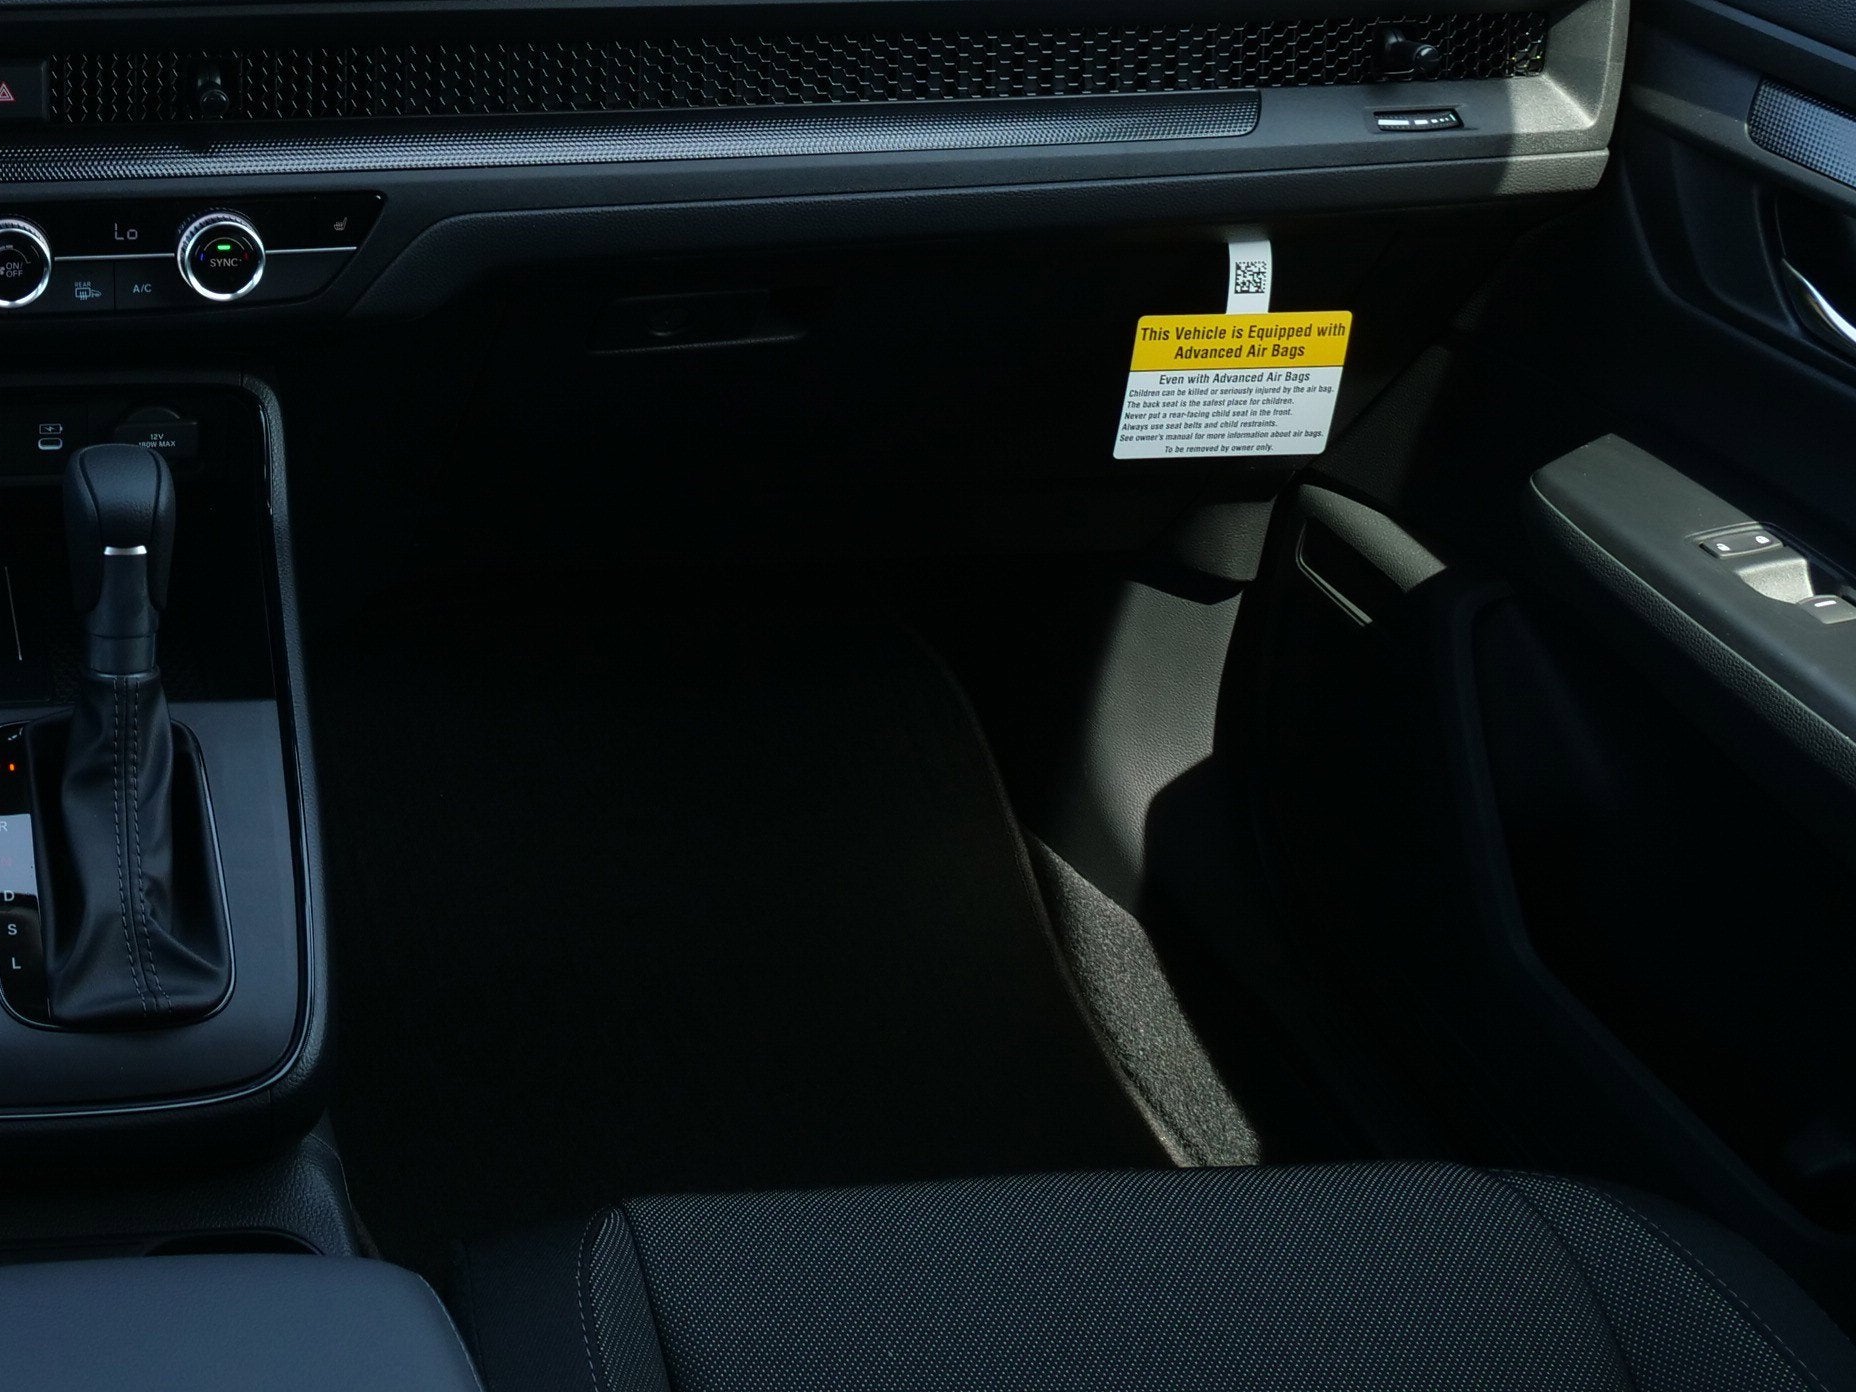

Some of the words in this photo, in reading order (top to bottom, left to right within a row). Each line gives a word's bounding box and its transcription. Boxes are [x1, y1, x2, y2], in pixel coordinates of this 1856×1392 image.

[114, 223, 138, 240] Lo
[210, 258, 238, 268] SYNC
[6, 270, 23, 278] OFF
[132, 283, 152, 293] A/C
[1141, 327, 1170, 341] This
[1175, 326, 1227, 340] Vehicle
[1231, 326, 1243, 339] is
[1248, 324, 1313, 341] Equipped
[1317, 323, 1346, 337] with
[1174, 345, 1243, 359] Advanced
[1246, 344, 1267, 358] Air
[1271, 344, 1305, 359] Bags
[1159, 374, 1184, 385] Even
[1187, 374, 1210, 384] with
[1212, 372, 1264, 384] Advanced
[1266, 372, 1283, 382] Air
[1284, 371, 1311, 383] Bags
[1129, 389, 1160, 397] Children
[1187, 388, 1208, 396] killed
[1220, 387, 1253, 395] seriously
[1255, 386, 1281, 394] injured
[1282, 386, 1291, 394] by
[1318, 385, 1334, 393] bag.
[1142, 400, 1160, 408] back
[1202, 399, 1226, 407] safest
[1227, 398, 1248, 407] place
[1262, 397, 1295, 405] children.
[1148, 412, 1161, 420] put
[1169, 410, 1210, 419] rear-facing
[1232, 409, 1248, 417] seat
[1122, 423, 1148, 431] Always
[1184, 421, 1202, 429] belts
[1119, 434, 1134, 442] See
[1135, 433, 1163, 441] owner's
[1165, 432, 1193, 440] manual
[1194, 432, 1205, 440] for
[1227, 431, 1269, 439] information
[1270, 430, 1291, 438] about
[1304, 429, 1324, 438] bags.
[1174, 445, 1184, 453] be
[1256, 443, 1274, 451] only.
[4, 890, 15, 901] D
[7, 924, 18, 935] S
[12, 957, 21, 969] L
